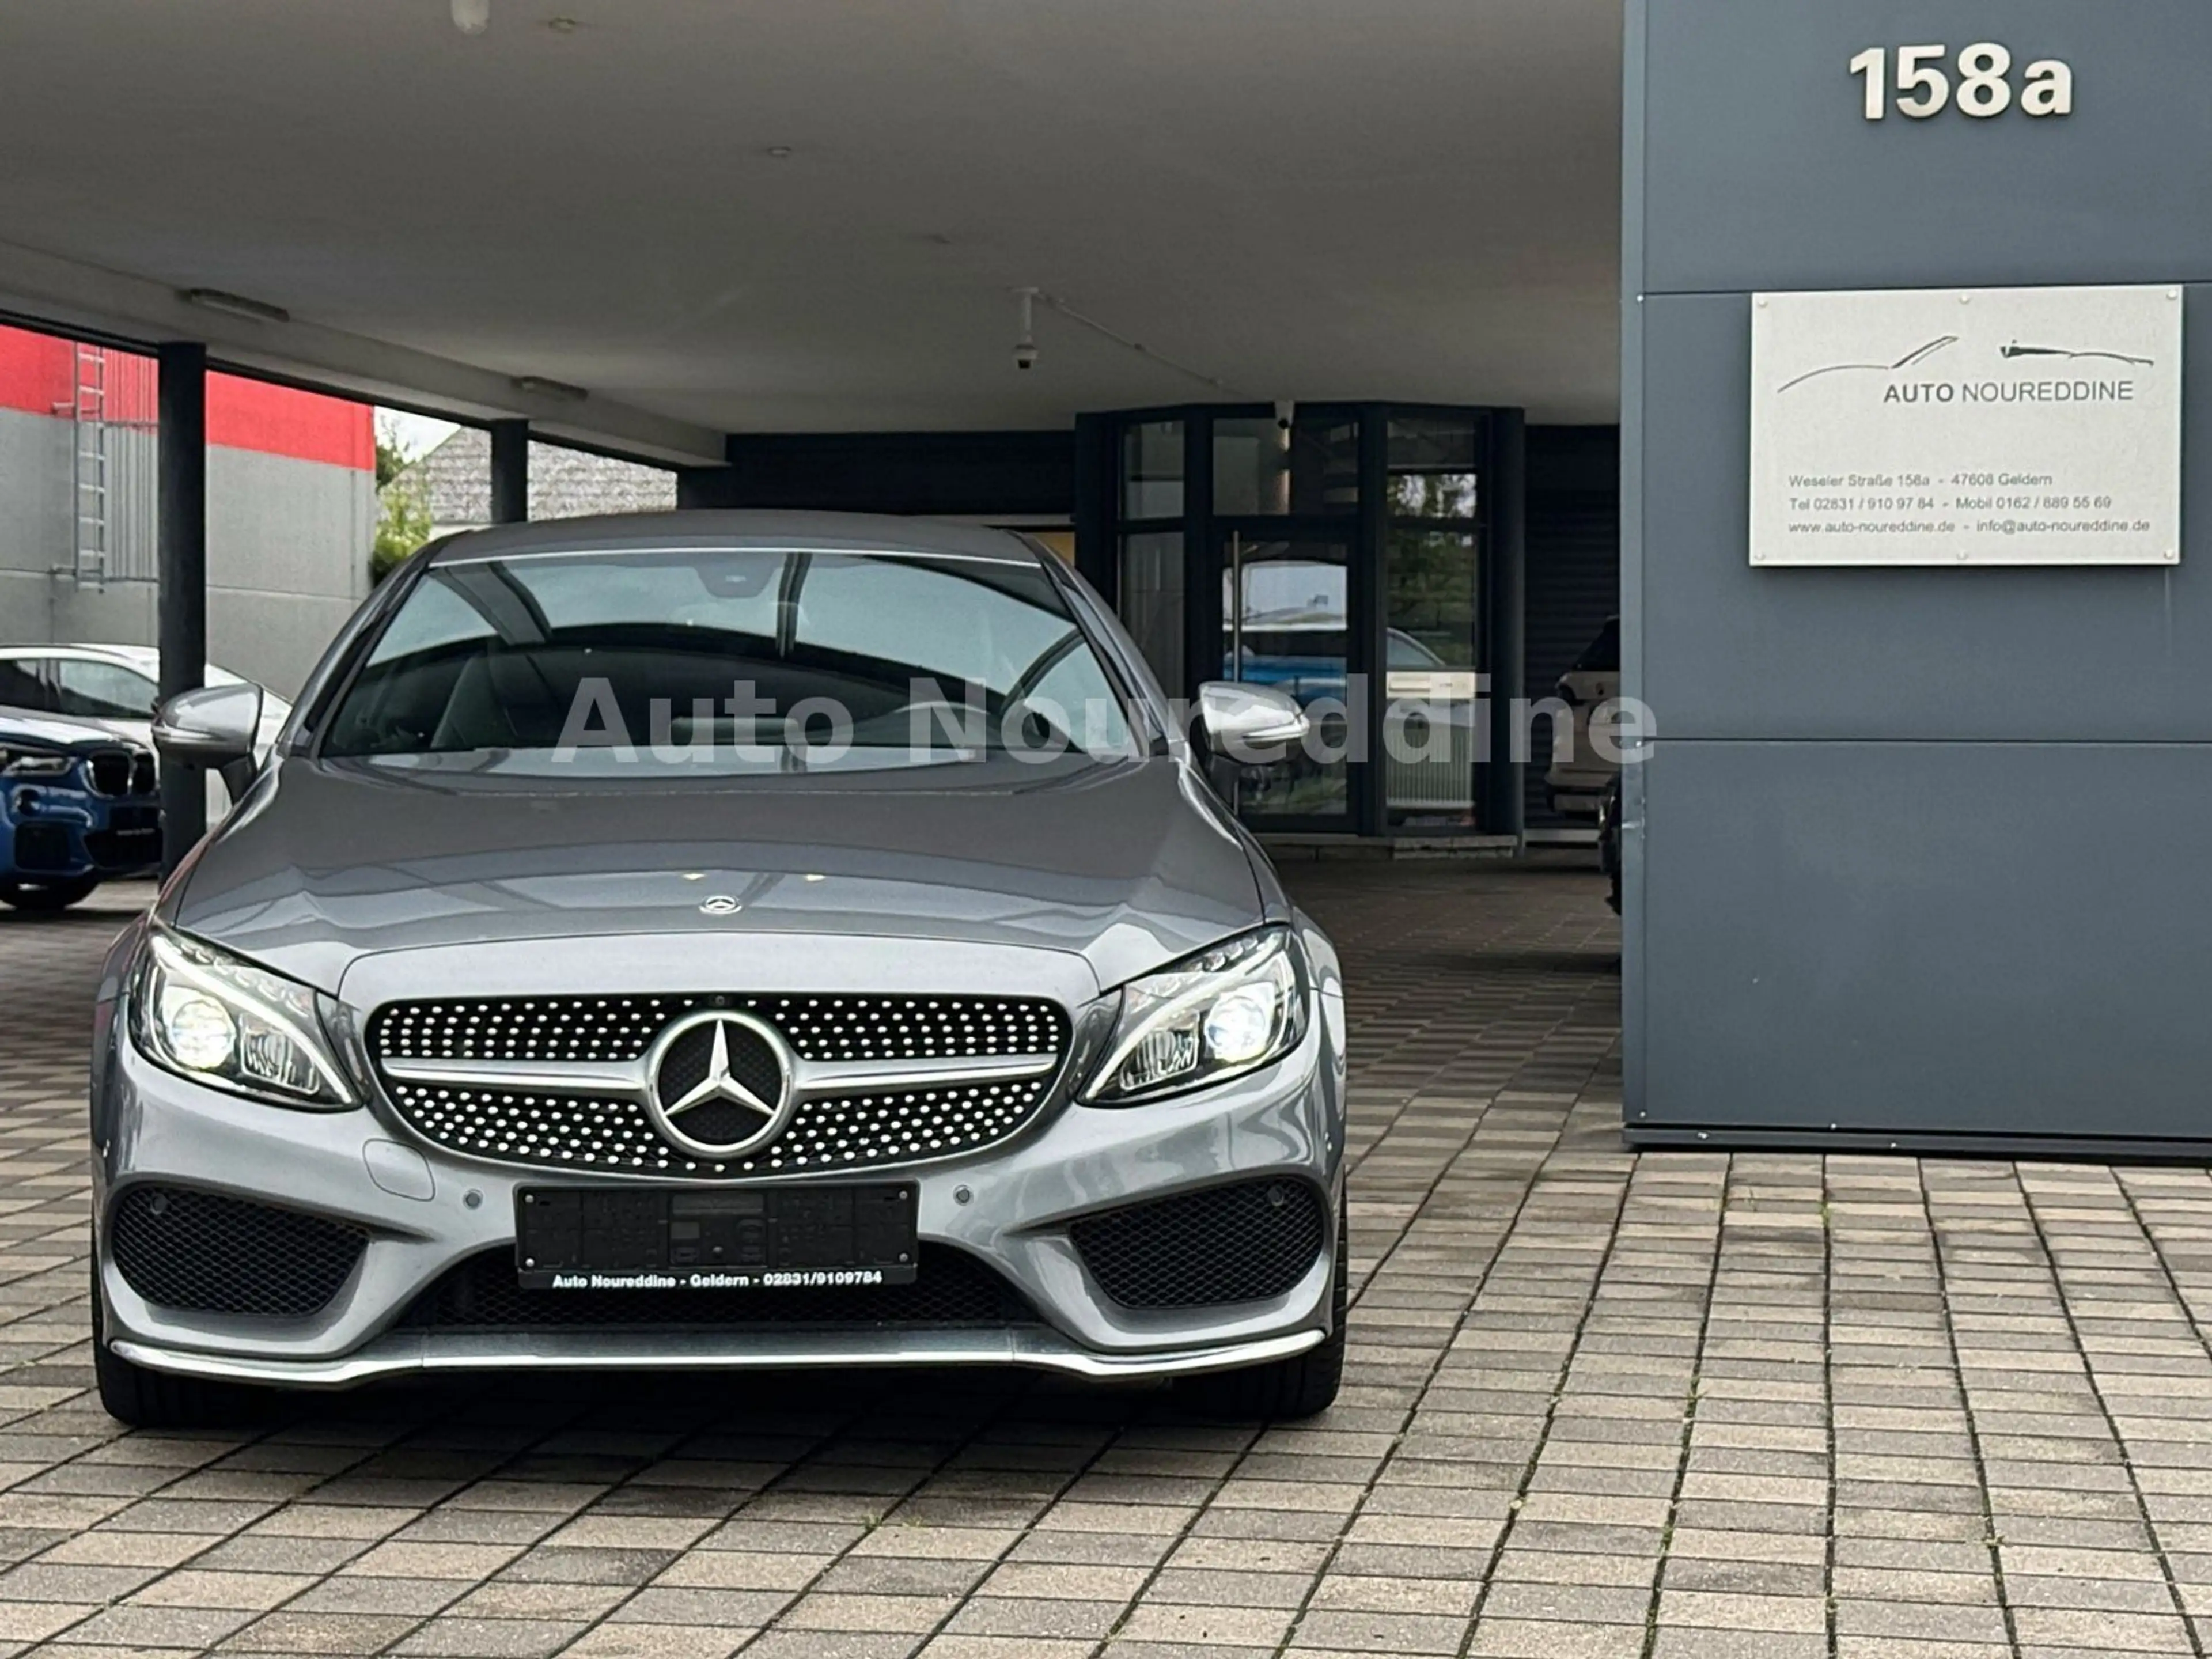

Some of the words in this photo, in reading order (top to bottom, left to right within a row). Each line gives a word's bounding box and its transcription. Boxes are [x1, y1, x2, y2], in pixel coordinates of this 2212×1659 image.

[1850, 42, 2072, 119] 158a
[1883, 383, 1954, 403] AUTO
[1962, 381, 2134, 402] NOUREDDINE
[1848, 474, 1893, 487] Straße
[1898, 474, 1930, 487] 158a
[1998, 473, 2052, 486] Geldern
[1790, 498, 1809, 510] Tel
[1814, 498, 1854, 510] 02831
[1858, 498, 1865, 510] /
[1868, 497, 1893, 510] 910
[1896, 497, 1914, 509] 97
[1918, 497, 1934, 509] 84
[1956, 497, 1993, 509] Mobil
[1996, 497, 2031, 509] 0162
[1789, 521, 1955, 533] www.auto-noureddine.de
[1976, 520, 2150, 535] info@auto-noureddine.de
[552, 1274, 588, 1288] Auto
[591, 1274, 676, 1288] Noureddine
[690, 1274, 749, 1287] Geldern
